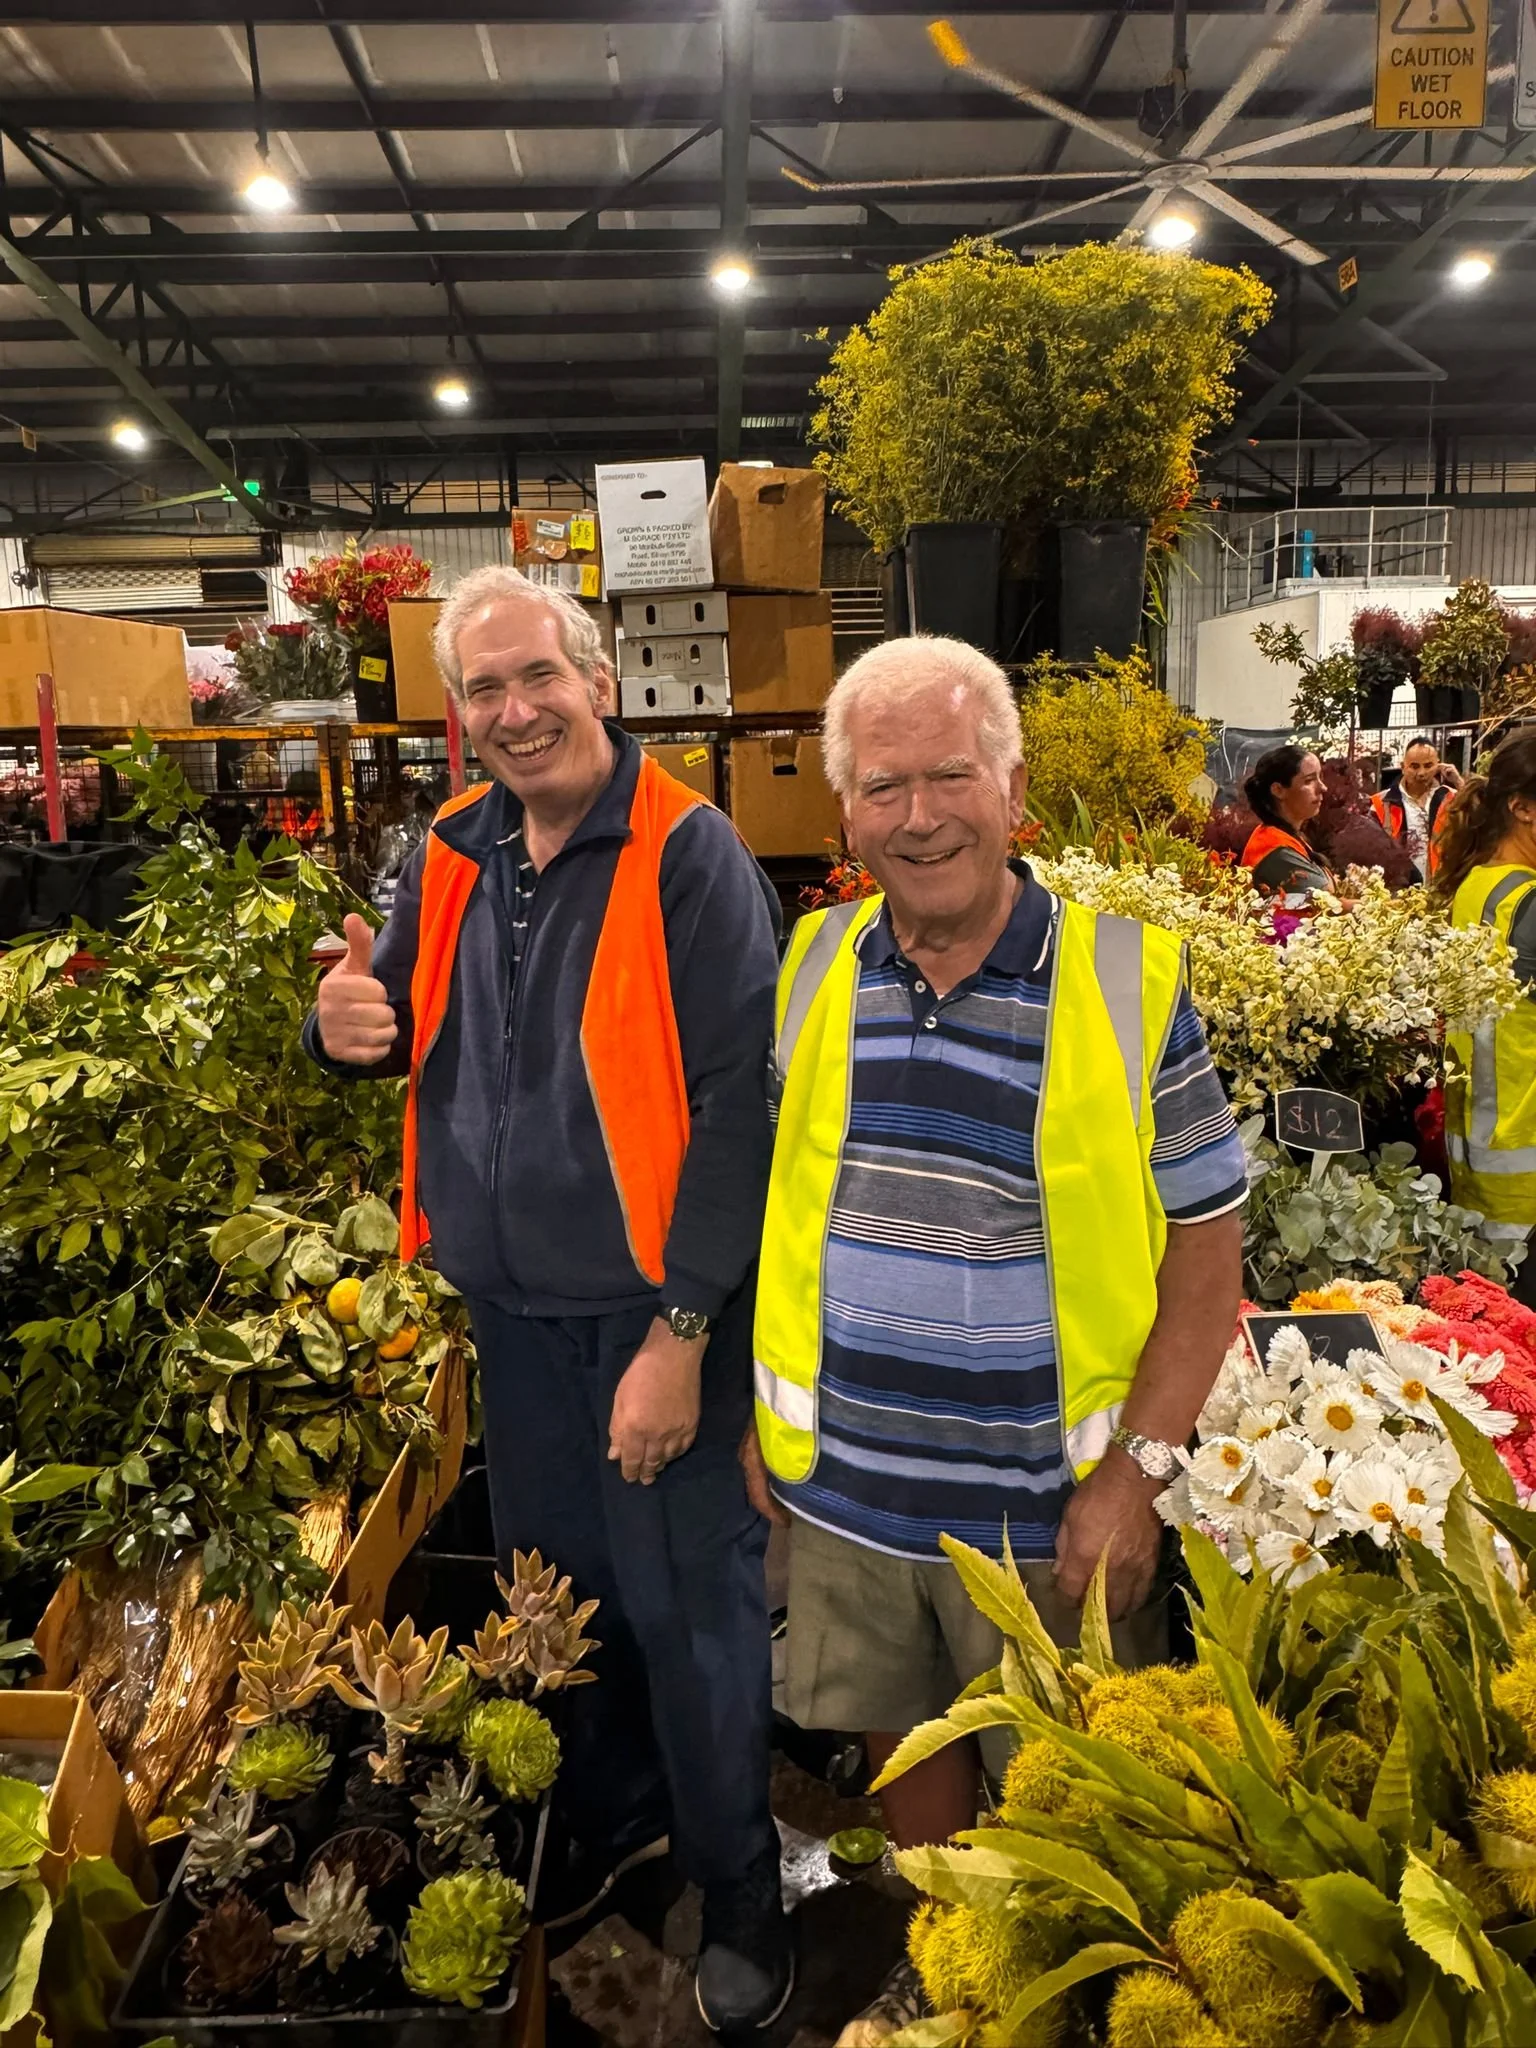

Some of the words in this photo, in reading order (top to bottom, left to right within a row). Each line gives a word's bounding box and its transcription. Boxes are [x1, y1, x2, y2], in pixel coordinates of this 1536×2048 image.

[1391, 47, 1474, 67] CAUTION
[1411, 73, 1453, 93] WET
[1398, 100, 1463, 120] FLOOR
[1287, 1096, 1347, 1139] $12
